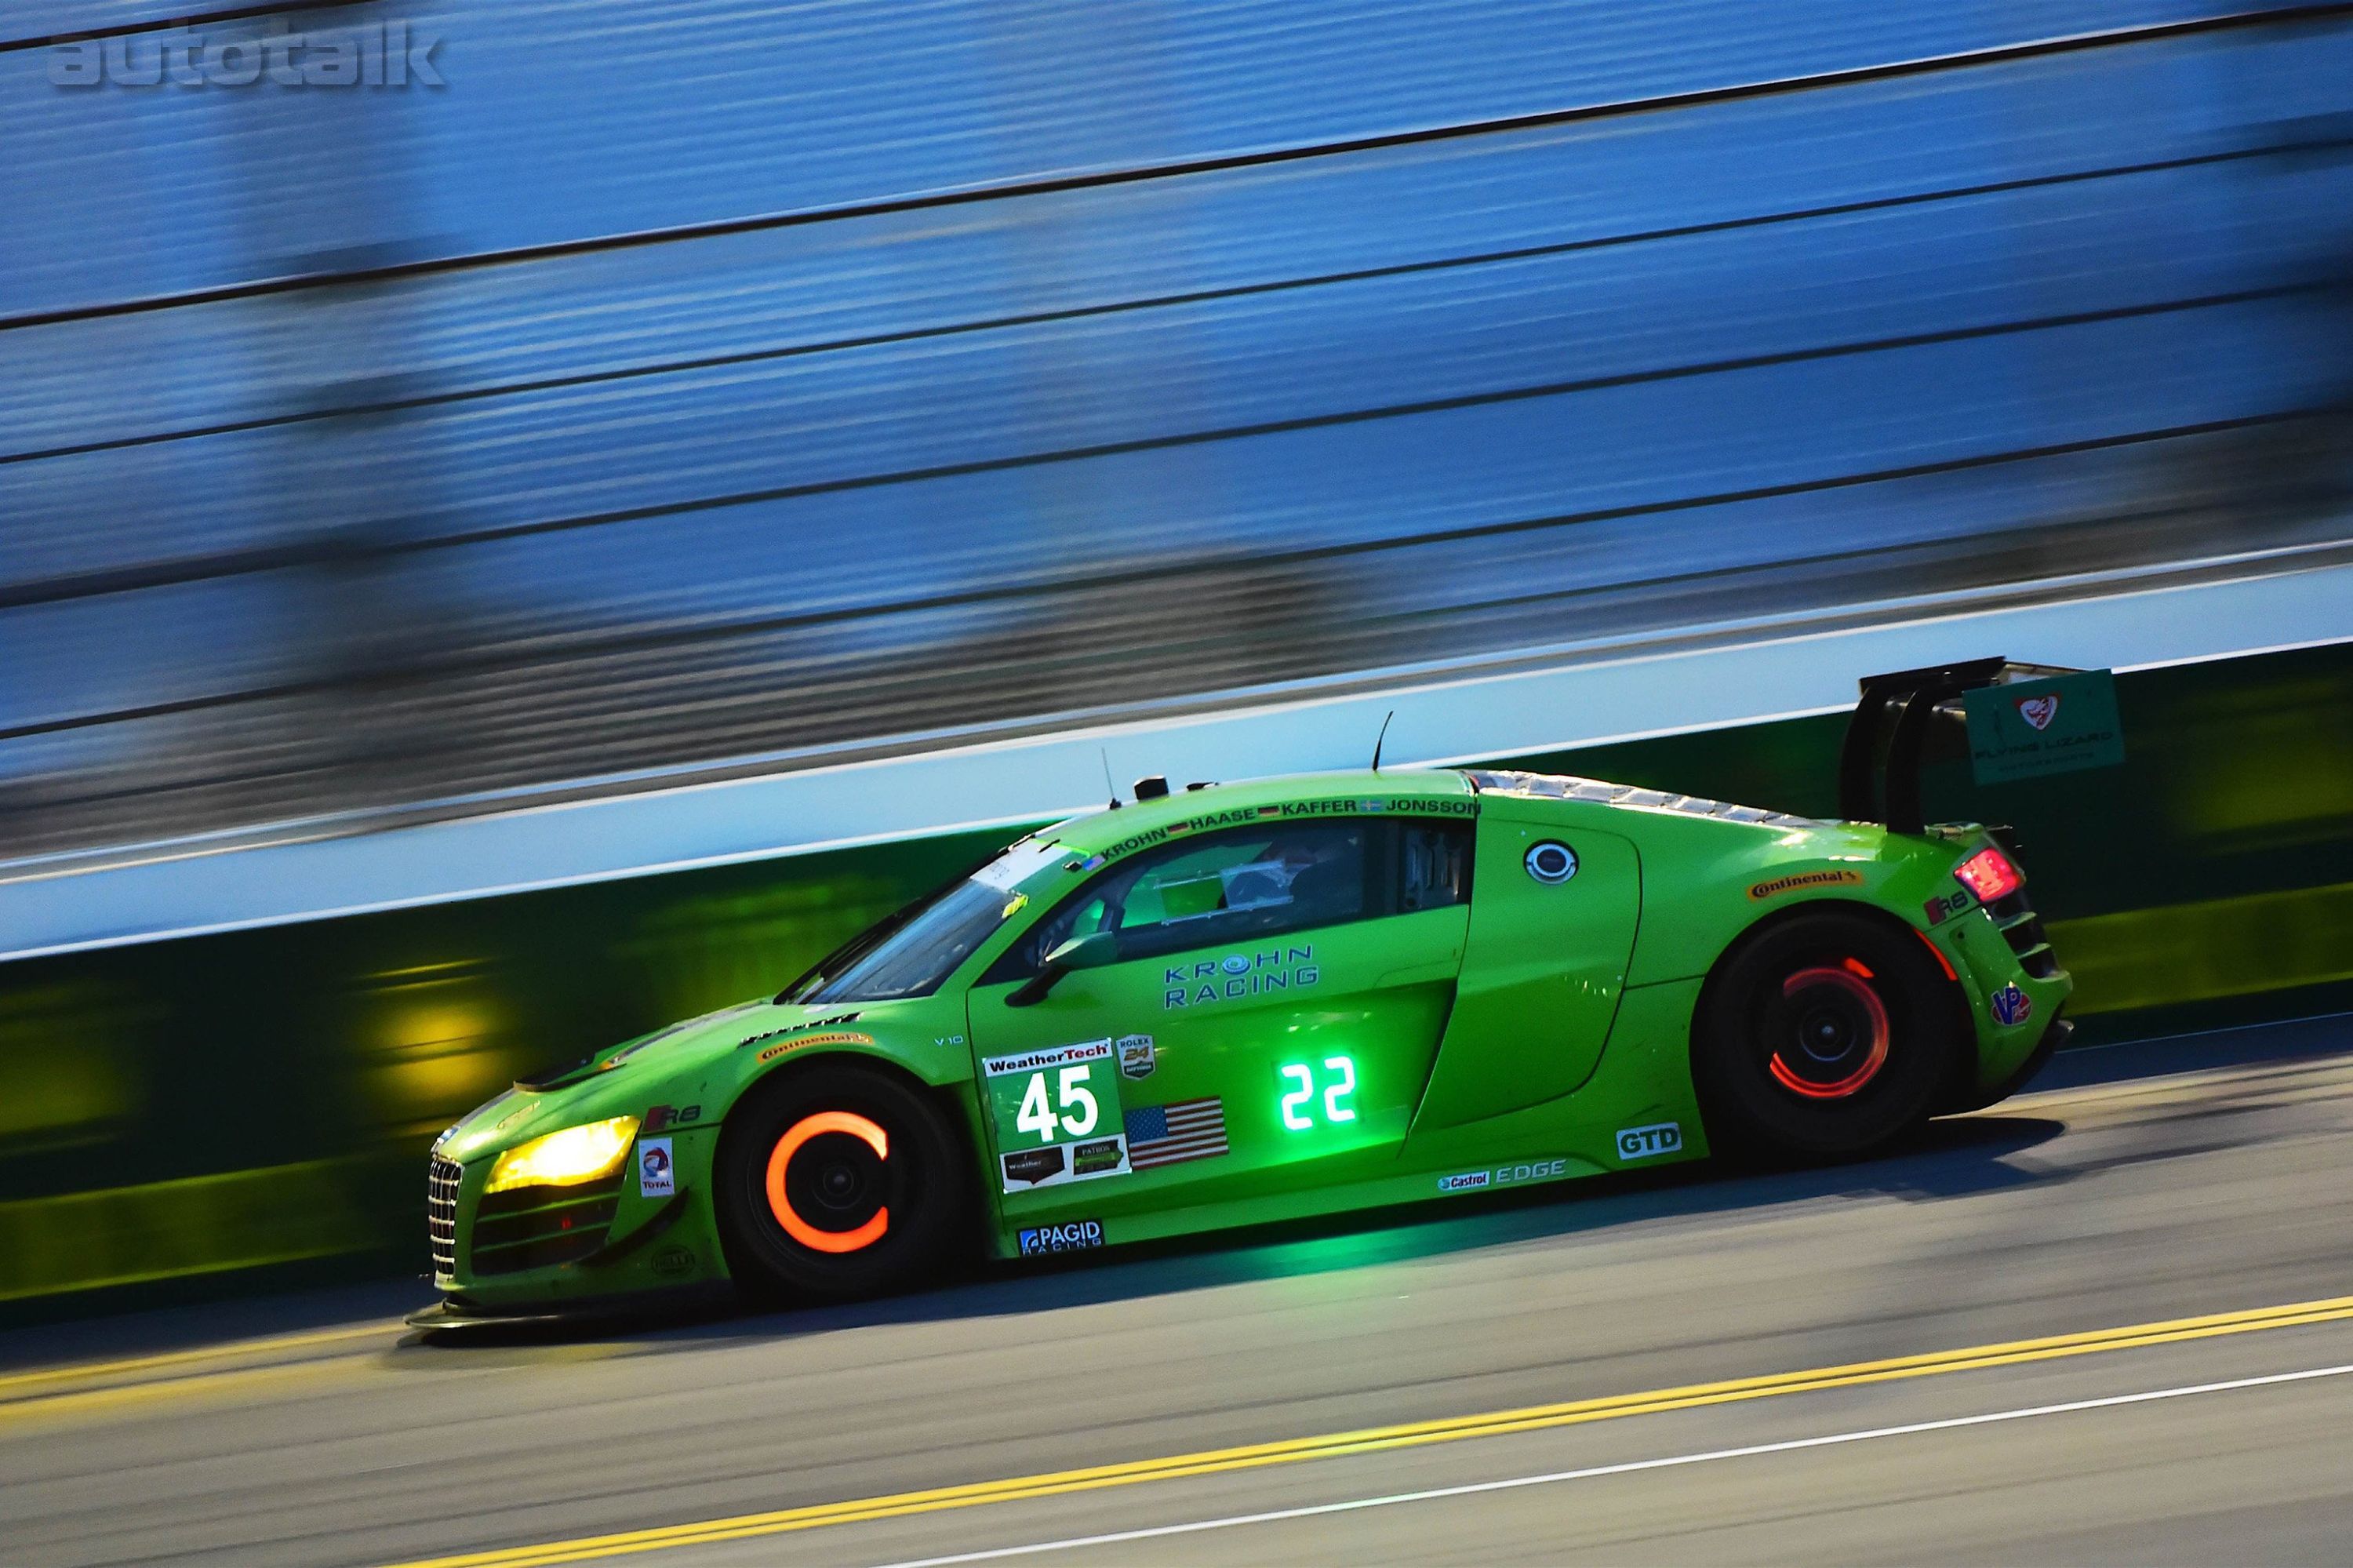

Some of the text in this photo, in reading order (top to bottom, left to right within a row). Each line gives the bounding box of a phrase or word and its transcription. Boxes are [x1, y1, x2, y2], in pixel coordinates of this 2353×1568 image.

[1100, 799, 1482, 861] KROHN HAASE KAFFER JONSSON
[1751, 870, 1843, 898] Continental
[1165, 944, 1313, 984] KROHN
[1164, 966, 1319, 1010] RACING
[1991, 986, 2022, 1025] VP
[762, 1033, 852, 1060] Continental
[1120, 1037, 1150, 1050] ROLEX
[1123, 1046, 1150, 1061] 24
[989, 1044, 1109, 1074] WeatherTech
[1016, 1064, 1100, 1143] 45
[1280, 1055, 1357, 1131] 22
[658, 1104, 702, 1124] R8
[1620, 1126, 1679, 1154] GTD
[642, 1180, 672, 1191] TOTAL
[1450, 1158, 1568, 1188] Castrol EDGE
[1022, 1237, 1102, 1256] RACING
[1039, 1221, 1101, 1246] PAGID
